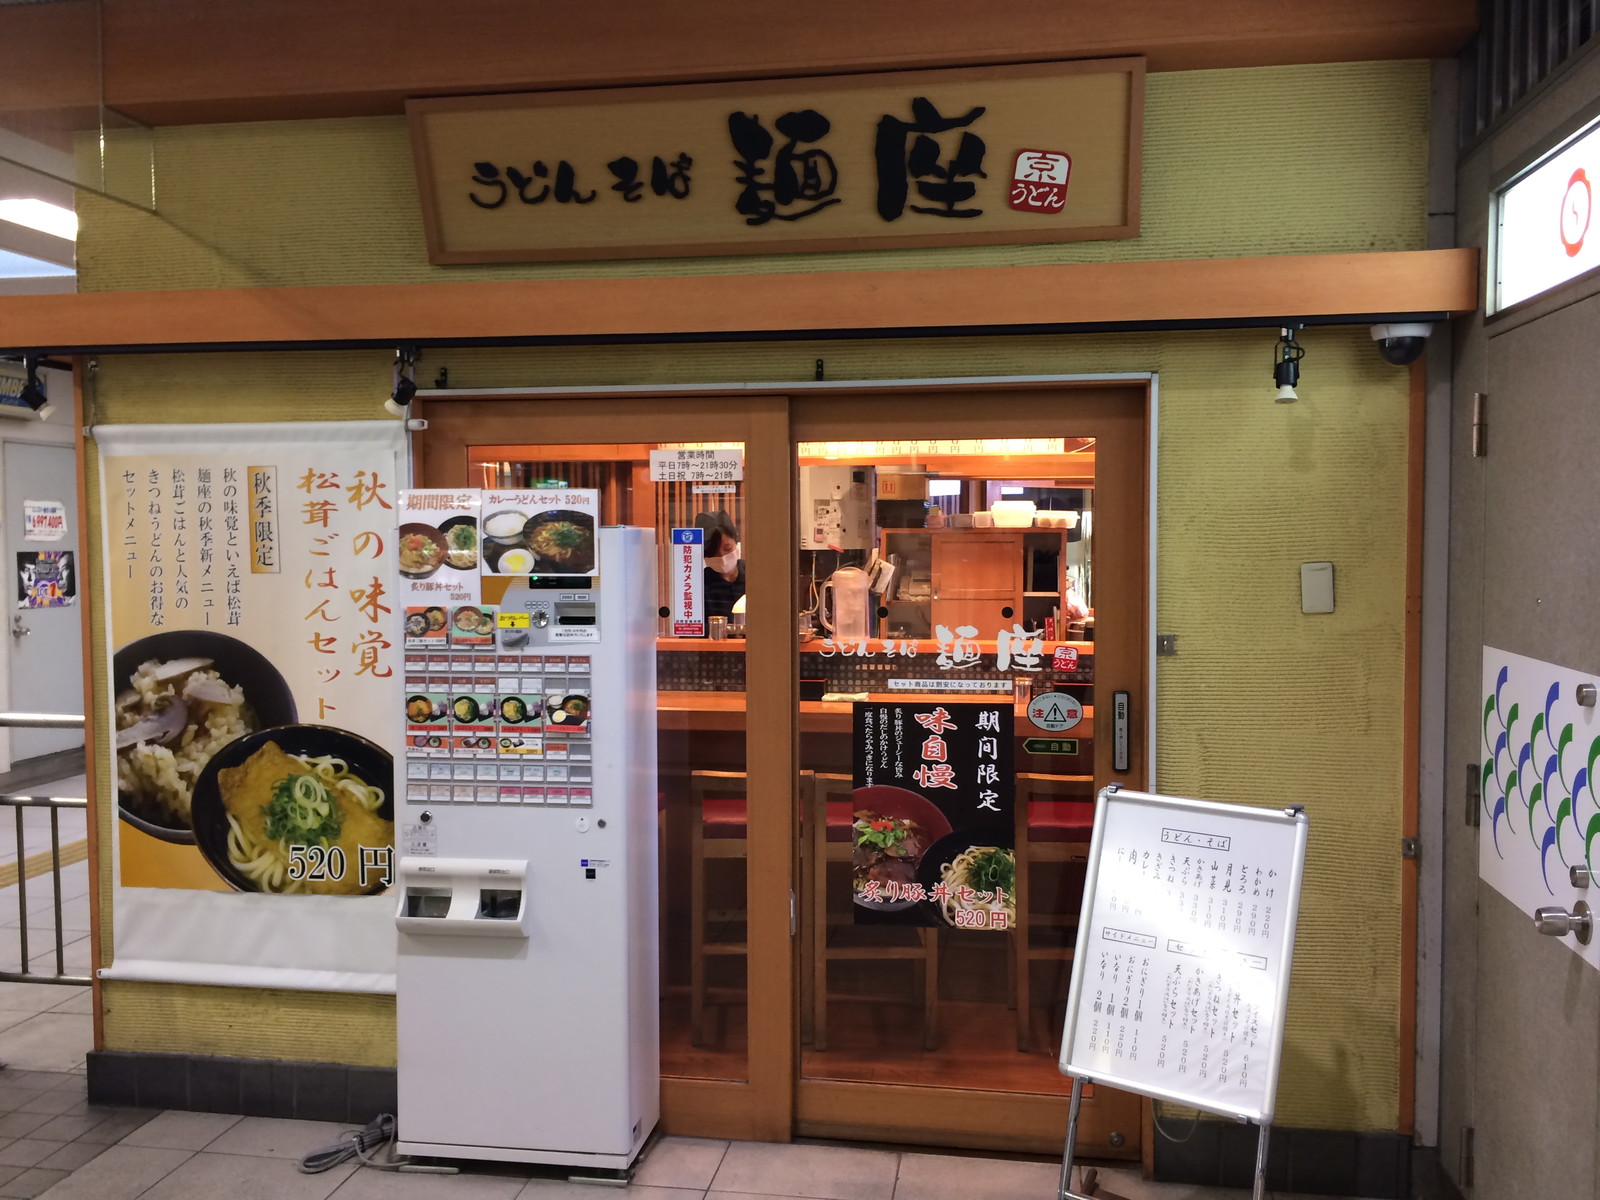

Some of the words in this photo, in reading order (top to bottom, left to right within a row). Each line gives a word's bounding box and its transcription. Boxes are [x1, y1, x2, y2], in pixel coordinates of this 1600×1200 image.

[469, 160, 596, 209] うどん
[608, 152, 694, 202] そば
[1011, 183, 1065, 208] うどん
[677, 450, 715, 460] 営業時間
[658, 471, 686, 480] 土日祝
[406, 493, 473, 511] 期間限定
[488, 494, 562, 506] カレーうどんセット
[565, 495, 590, 505] 520円
[122, 469, 137, 579] セットメニュー
[253, 471, 274, 567] 秋季限定
[148, 469, 164, 626] きつねうどんのお得な
[172, 469, 189, 609] 松茸ごはんと人気の
[223, 467, 241, 627] 秋の味覚といえば松茸
[346, 470, 393, 678] 秋の味覚
[683, 545, 693, 619] 防犯カメラ監視中
[296, 467, 341, 720] 松茸ごはんセット
[818, 638, 876, 658] うどん
[881, 638, 919, 658] そば
[1053, 658, 1077, 670] うどん
[893, 680, 1008, 689] セット商品は割安になっております
[1117, 702, 1125, 720] 自動
[912, 706, 958, 790] 味自慢
[975, 710, 1002, 812] 期間限定
[1051, 742, 1071, 751] 自動
[1163, 831, 1228, 849] うどん・そば
[288, 844, 347, 882] 520
[358, 844, 395, 887] 円
[1208, 860, 1219, 890] 山菜
[1222, 863, 1233, 893] 月見
[1238, 865, 1249, 894] とろろ
[858, 879, 1010, 906] 炙り豚丼セット
[1252, 867, 1262, 897] わかめ
[1265, 868, 1277, 898] かけ
[954, 909, 985, 928] 520
[990, 911, 1008, 929] 円
[1261, 906, 1272, 939] 220円
[1105, 930, 1155, 944] サイドメニュー
[1099, 951, 1109, 981] いなり
[1112, 954, 1122, 984] いなり
[1125, 955, 1136, 995] おにぎり
[1139, 957, 1149, 998] おにぎり
[1190, 967, 1204, 1034] かきあげセット
[1089, 1019, 1098, 1051] 220円
[1115, 1025, 1125, 1058] 220円
[1129, 1028, 1138, 1061] 110円
[1156, 1035, 1167, 1068] 520円
